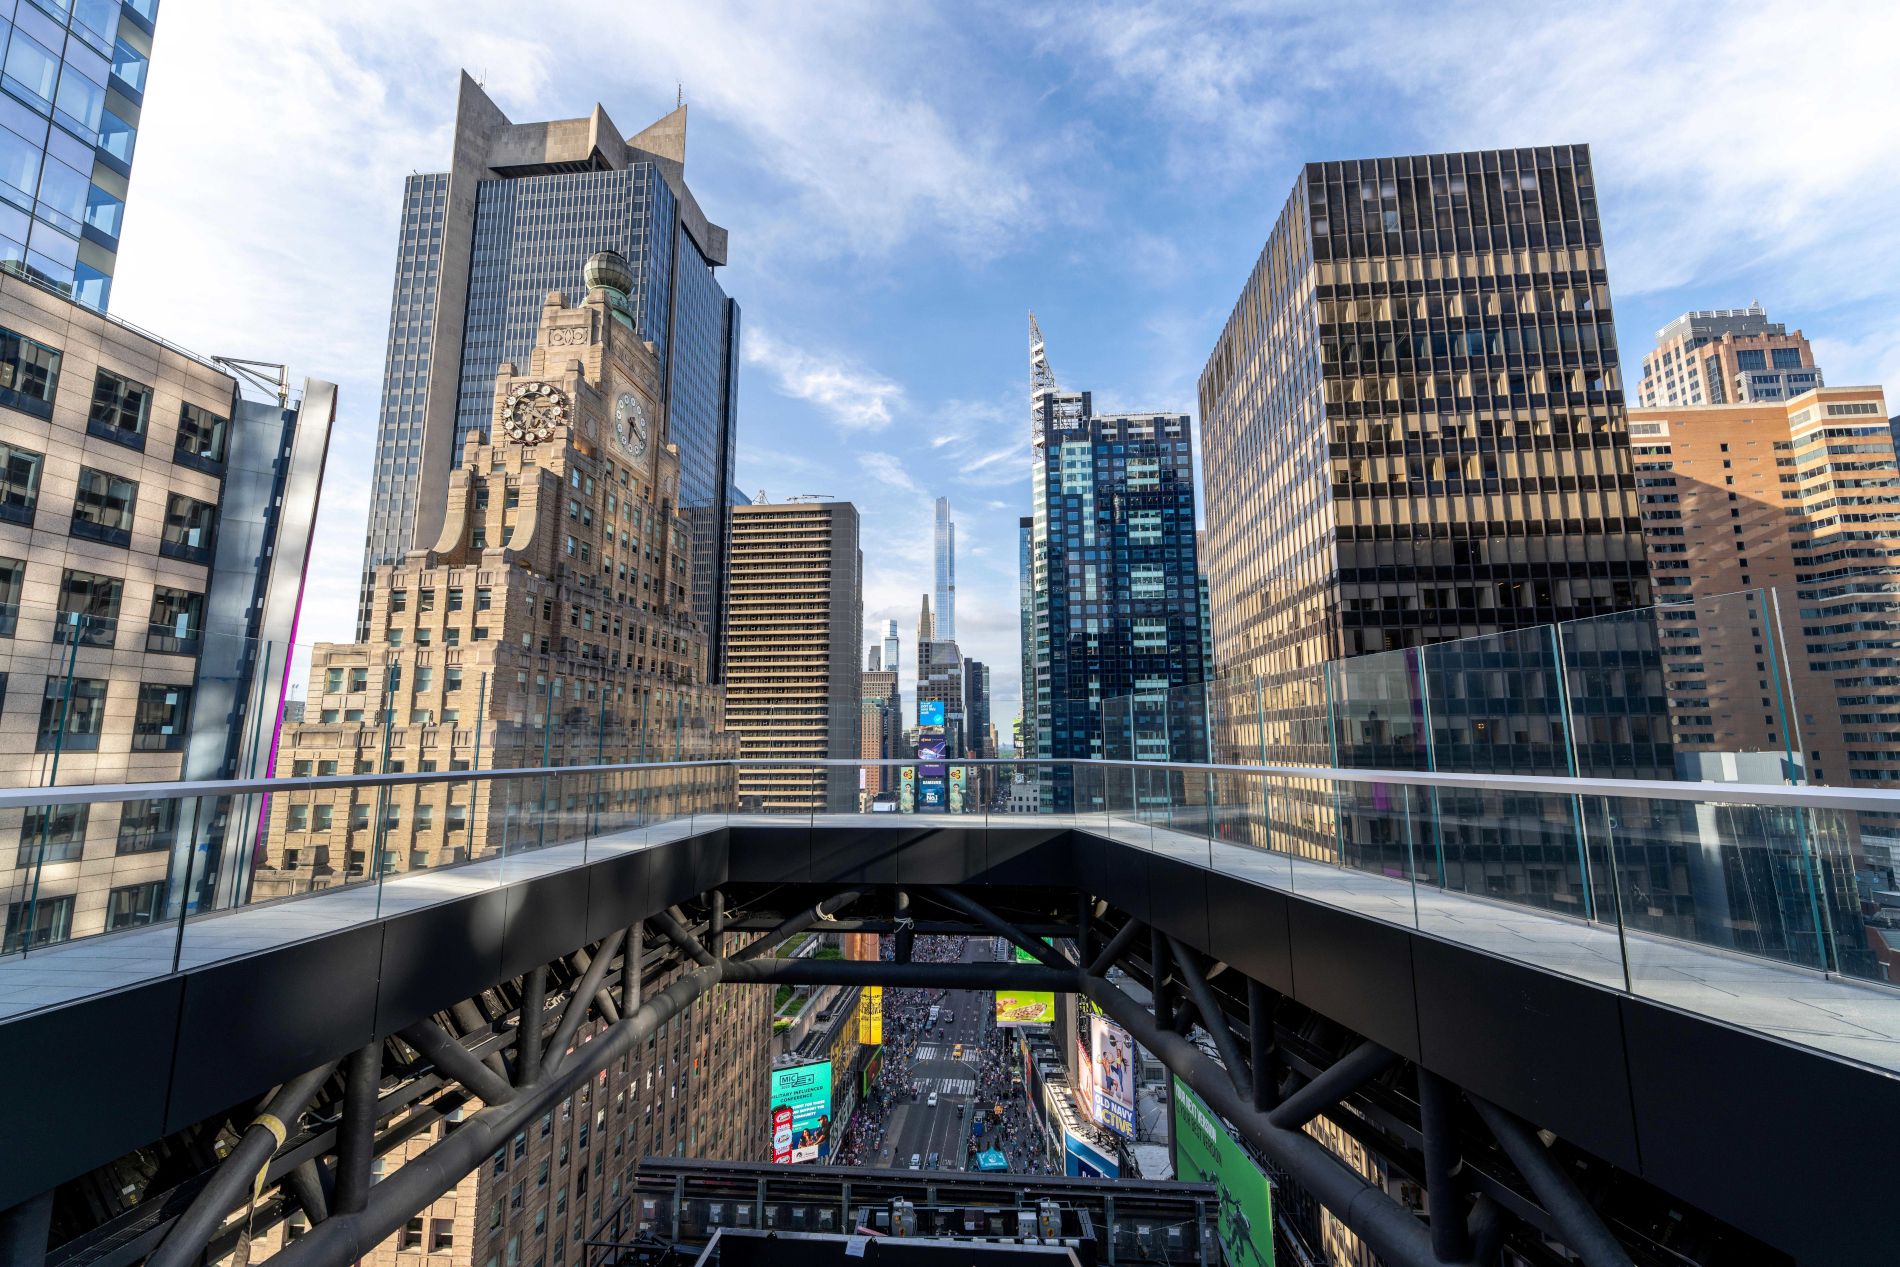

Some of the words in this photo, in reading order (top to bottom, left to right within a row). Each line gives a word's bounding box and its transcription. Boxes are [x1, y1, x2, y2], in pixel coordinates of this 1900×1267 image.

[780, 1093, 812, 1103] CONFERENCE
[1095, 1093, 1110, 1109] OLD
[1111, 1102, 1133, 1122] NAVY
[1095, 1104, 1133, 1136] ACTIVE
